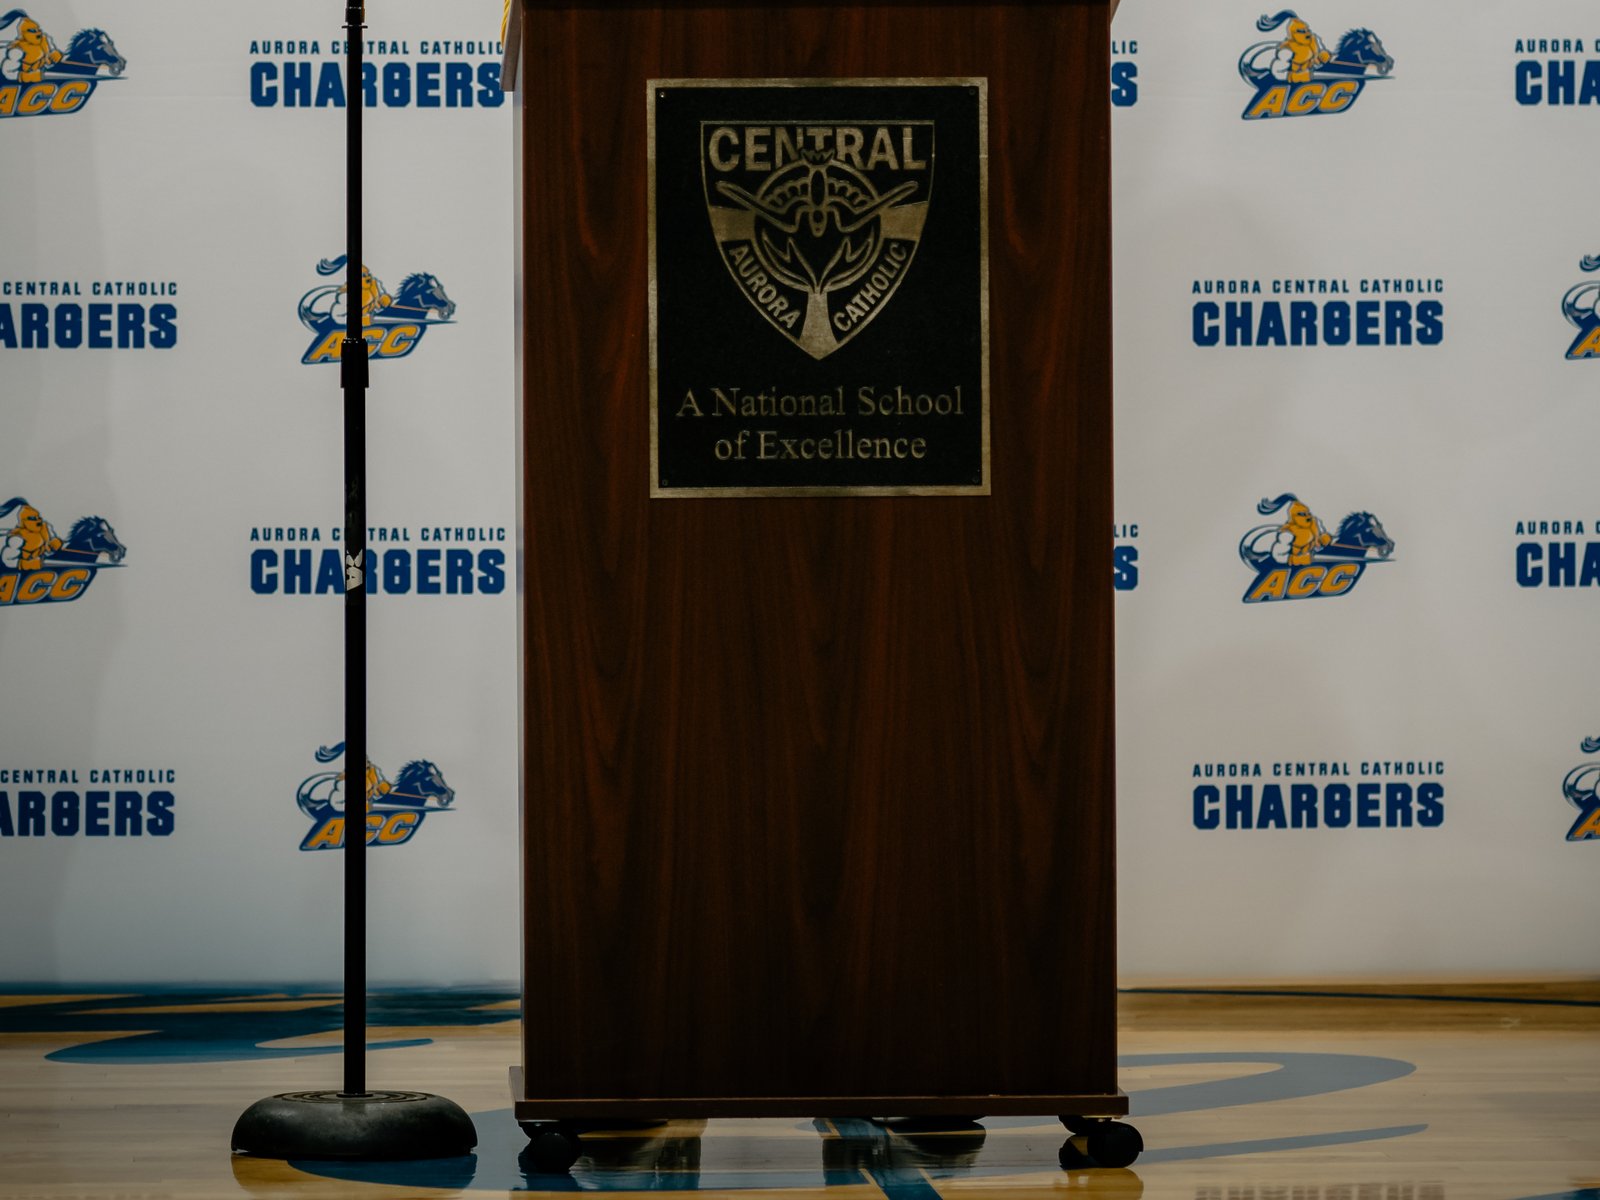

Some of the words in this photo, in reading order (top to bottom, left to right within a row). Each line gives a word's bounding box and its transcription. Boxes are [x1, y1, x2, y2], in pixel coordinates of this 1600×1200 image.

[250, 41, 320, 55] AURORA
[331, 41, 410, 55] CTRAL
[1515, 39, 1584, 53] AURORA
[1244, 80, 1359, 119] ACC
[708, 126, 928, 172] CENTRAL
[3, 282, 82, 296] CENTRAL
[92, 282, 177, 296] CATHOLIC
[729, 243, 803, 330] AURORA
[832, 241, 909, 332] CATHOLIC
[1191, 280, 1262, 293] AURORA
[1273, 280, 1350, 293] CENTRAL
[1360, 279, 1444, 293] CATHOLIC
[1193, 300, 1444, 347] CHARGERS
[675, 388, 704, 417] A
[712, 385, 847, 417] National
[857, 385, 964, 417] School
[713, 430, 750, 461] of
[755, 429, 927, 460] Excellence
[250, 528, 321, 541] AURORA
[331, 528, 410, 541] CTRAL
[421, 528, 506, 541] CATHOLIC
[1515, 521, 1585, 535] AURORA
[1245, 563, 1360, 602] ACC
[0, 770, 79, 784] CENTRAL
[90, 770, 175, 784] CATHOLIC
[1193, 763, 1262, 777] AURORA
[1273, 763, 1350, 776] CENTRAL
[1360, 762, 1444, 776] CATHOLIC
[1193, 782, 1444, 830] CHARGERS
